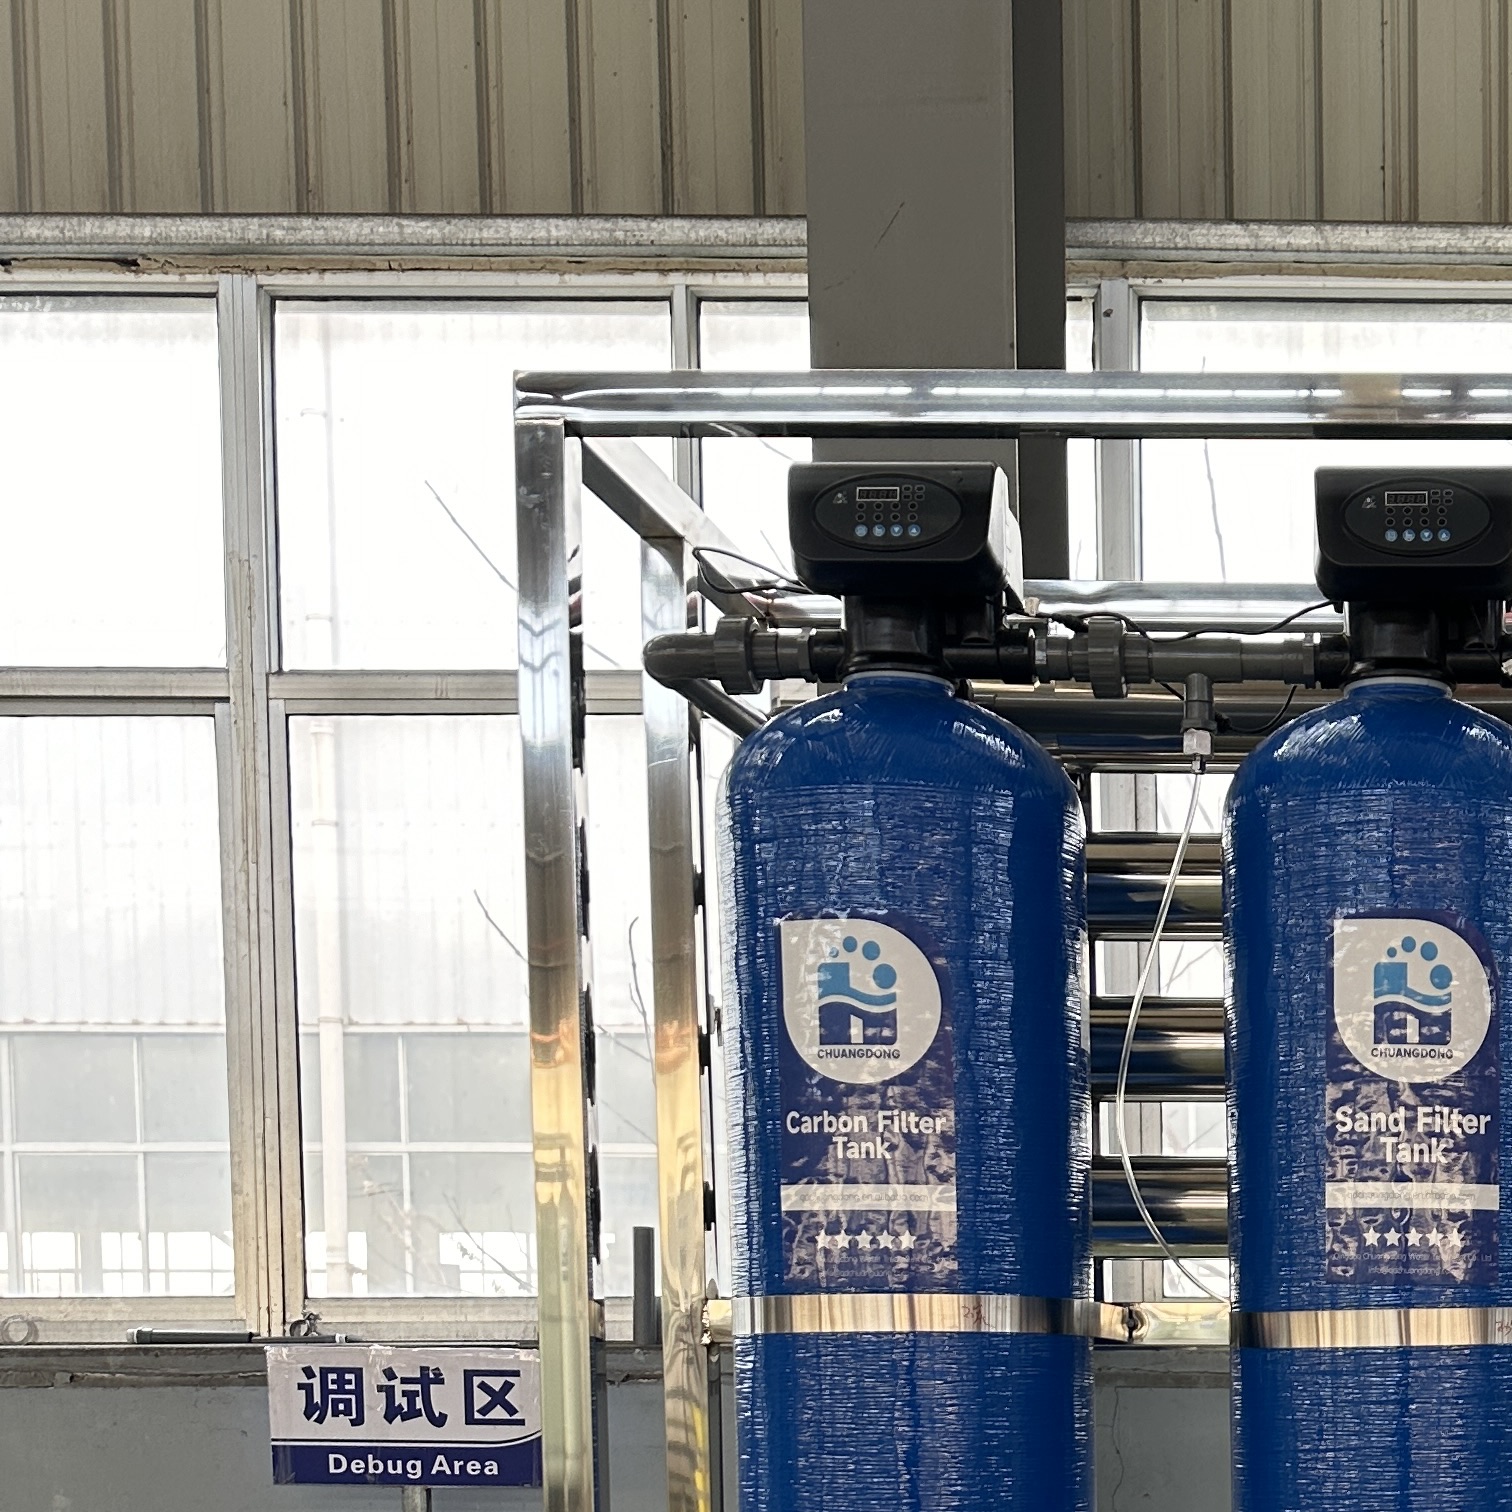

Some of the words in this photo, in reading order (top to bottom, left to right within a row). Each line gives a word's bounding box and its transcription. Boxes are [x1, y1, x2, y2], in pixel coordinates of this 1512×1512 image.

[817, 1048, 901, 1060] CHUANGDONG
[1371, 1047, 1454, 1060] CHUANGDONG
[786, 1110, 869, 1135] Carbon
[878, 1110, 947, 1135] Filter
[1335, 1105, 1406, 1135] Sand
[1417, 1105, 1492, 1137] Filter
[832, 1136, 892, 1160] Tank
[1380, 1136, 1448, 1164] Tank
[297, 1364, 526, 1428] 调试区
[328, 1453, 423, 1480] Debug
[431, 1454, 500, 1476] Area
